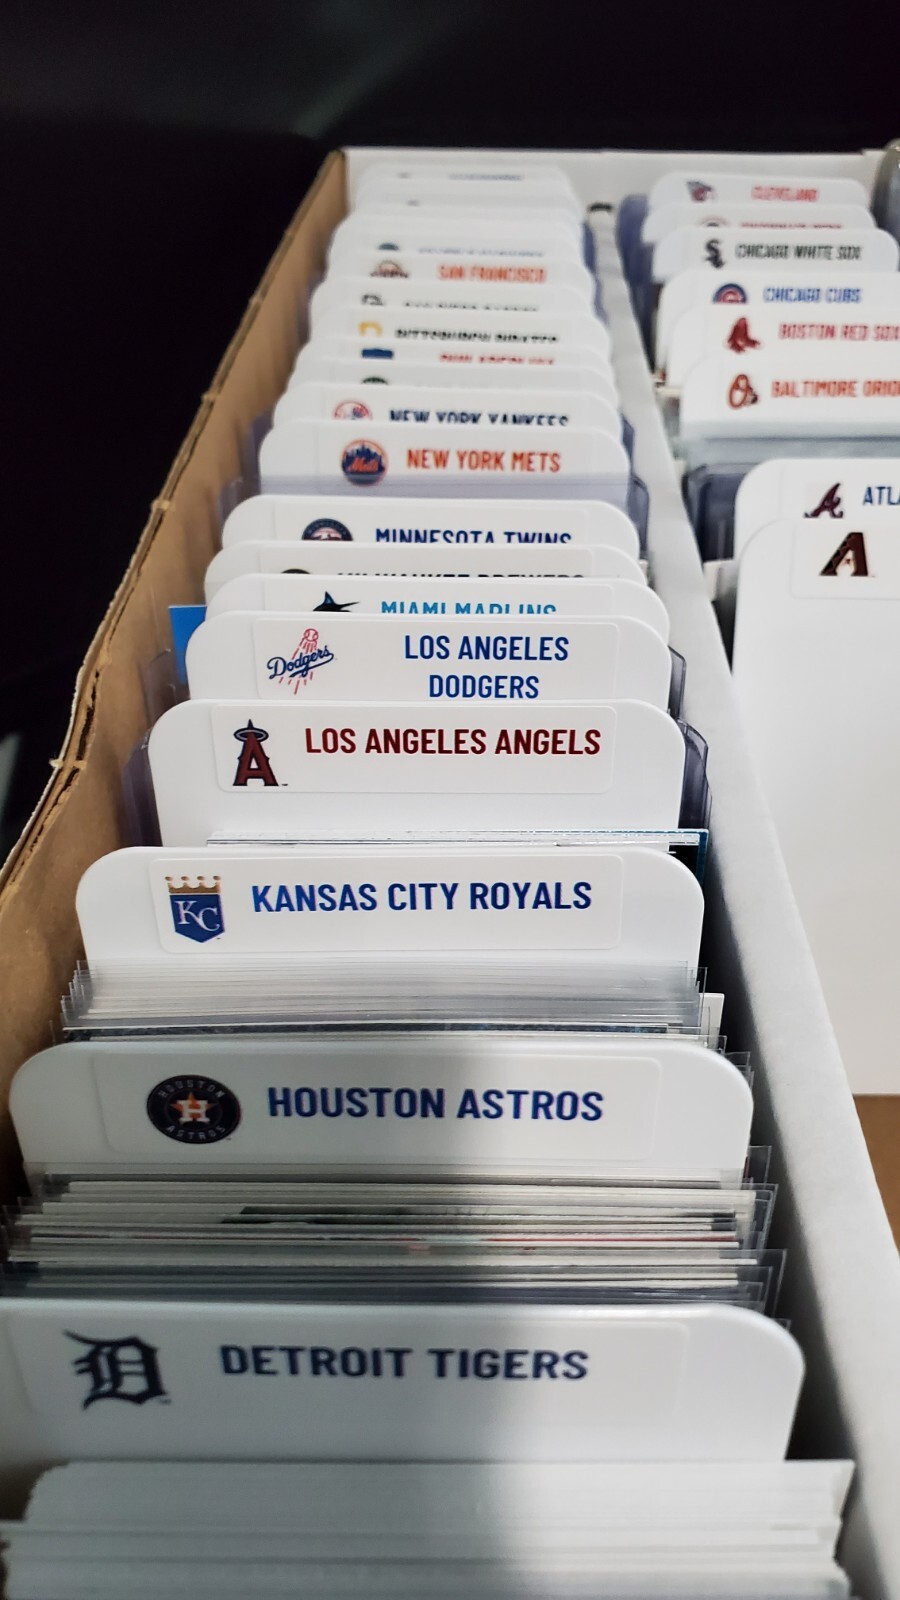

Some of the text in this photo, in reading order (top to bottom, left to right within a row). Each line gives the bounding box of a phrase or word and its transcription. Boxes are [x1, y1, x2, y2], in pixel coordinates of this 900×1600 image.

[735, 243, 864, 262] CHICAGO WHITE SOX
[437, 264, 547, 284] SAN FRANCISCO
[763, 287, 862, 304] CHICAGO CUBS
[779, 323, 837, 341] BOSTON
[841, 324, 869, 341] RED
[771, 380, 858, 398] BALTIMORE
[389, 409, 430, 423] NEW
[406, 448, 562, 473] NEW YORK METS
[375, 528, 572, 544] MINNESOTA TWINS
[404, 634, 570, 662] LOS ANGELES
[266, 644, 335, 680] Dodgers
[429, 674, 540, 699] DODGERS
[305, 727, 602, 756] LOS ANGELES ANGELS
[252, 881, 592, 913] KANSAS CITY ROYALS
[173, 900, 221, 932] KC
[268, 1086, 604, 1122] HOUSTON ASTROS
[220, 1344, 589, 1381] DETROIT TIGERS
